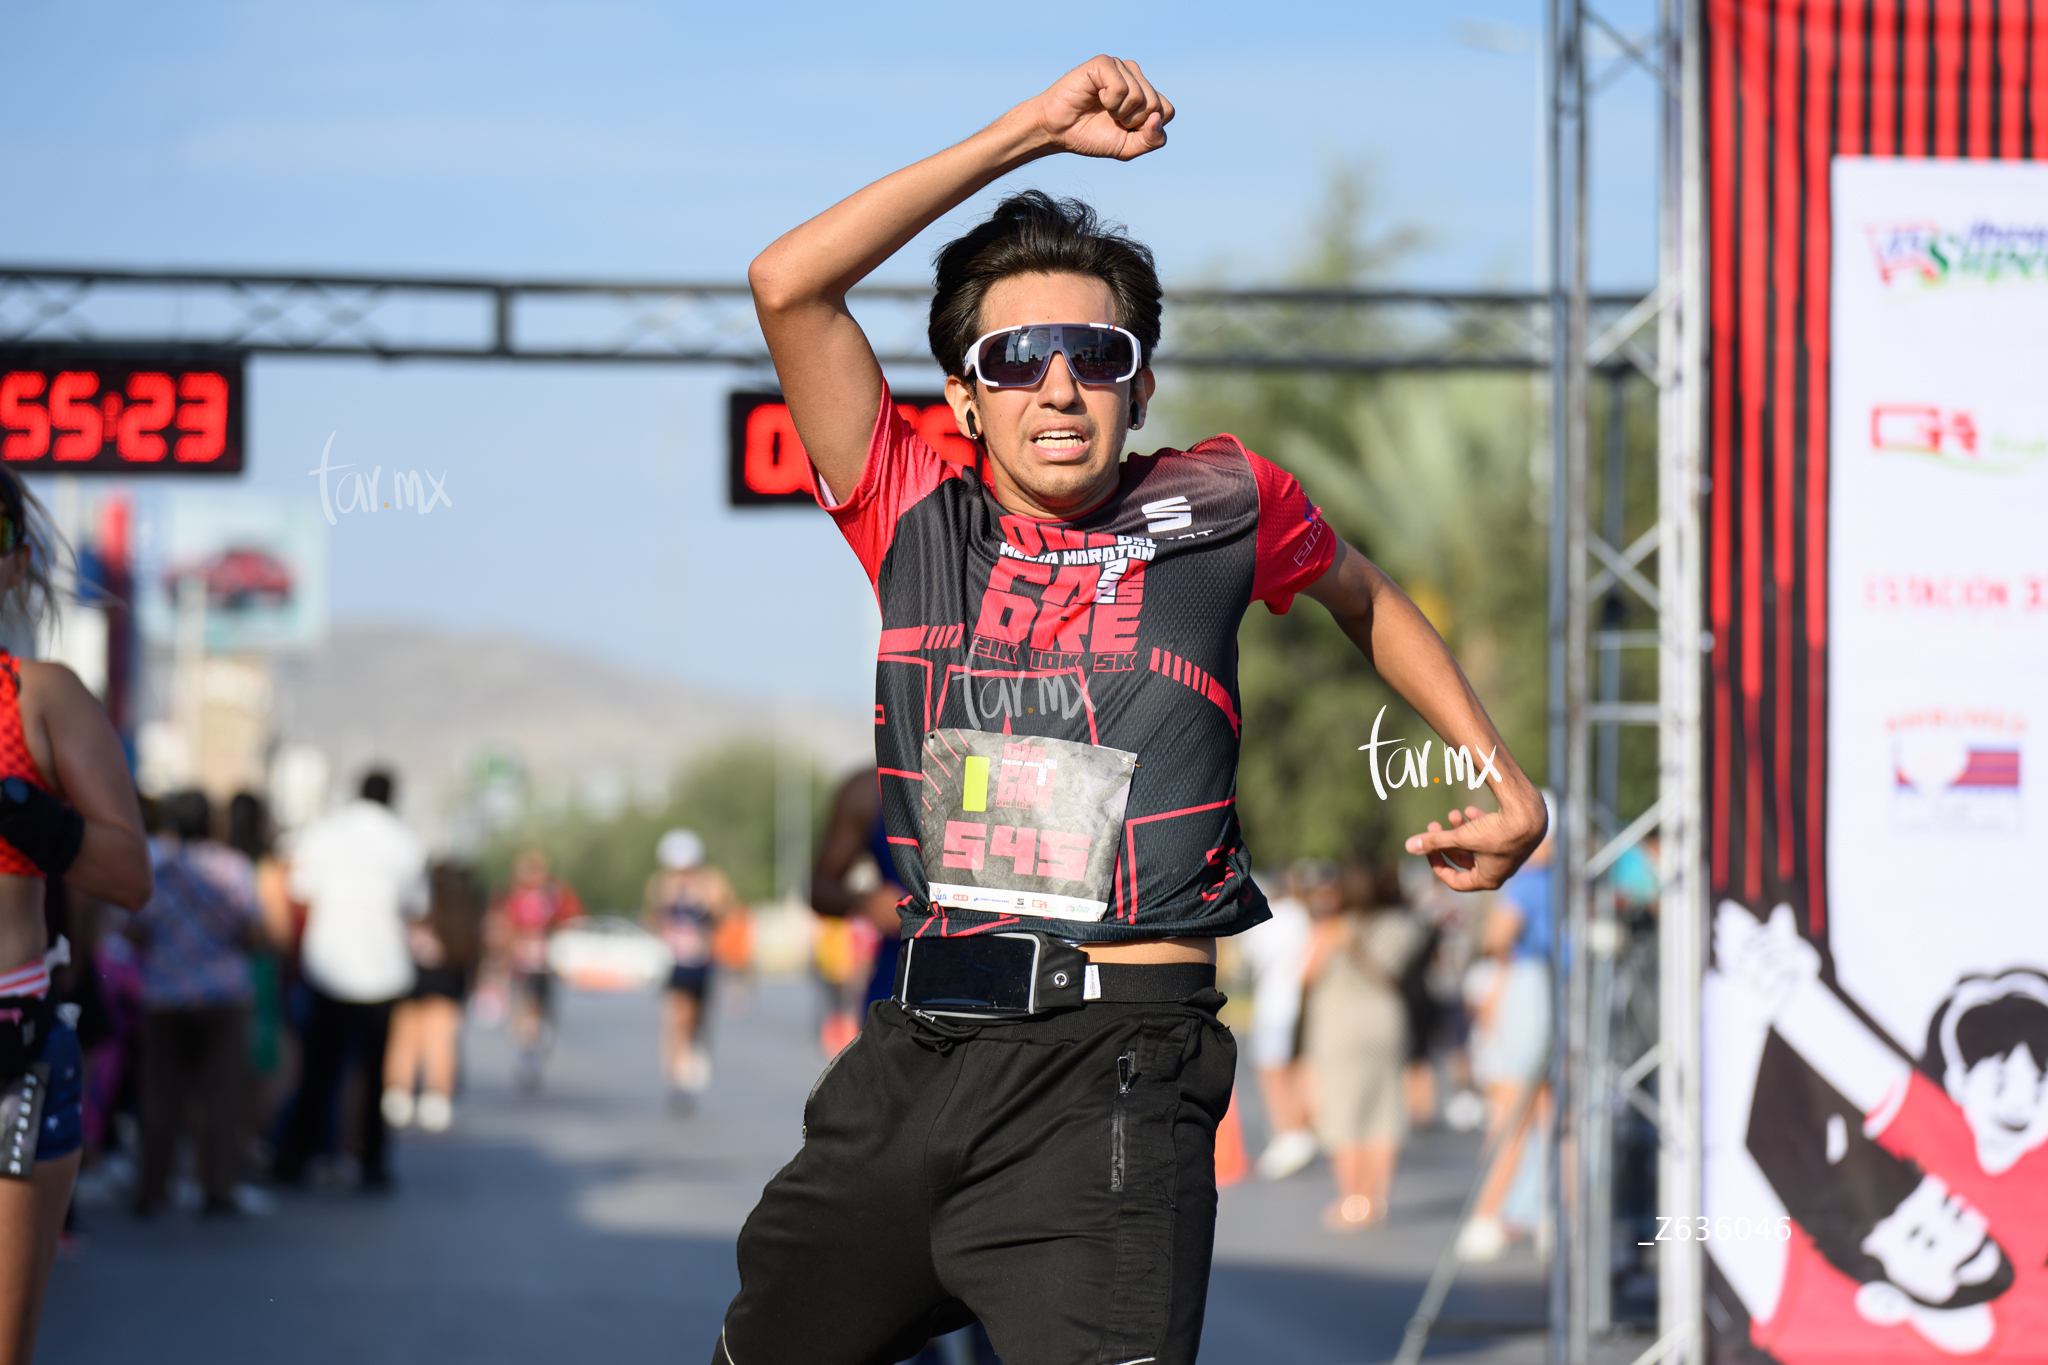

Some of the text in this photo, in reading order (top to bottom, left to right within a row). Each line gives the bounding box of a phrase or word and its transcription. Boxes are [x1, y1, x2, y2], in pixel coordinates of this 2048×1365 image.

[972, 634, 1138, 673] 21K 10K 5K
[942, 820, 1091, 881] 545
